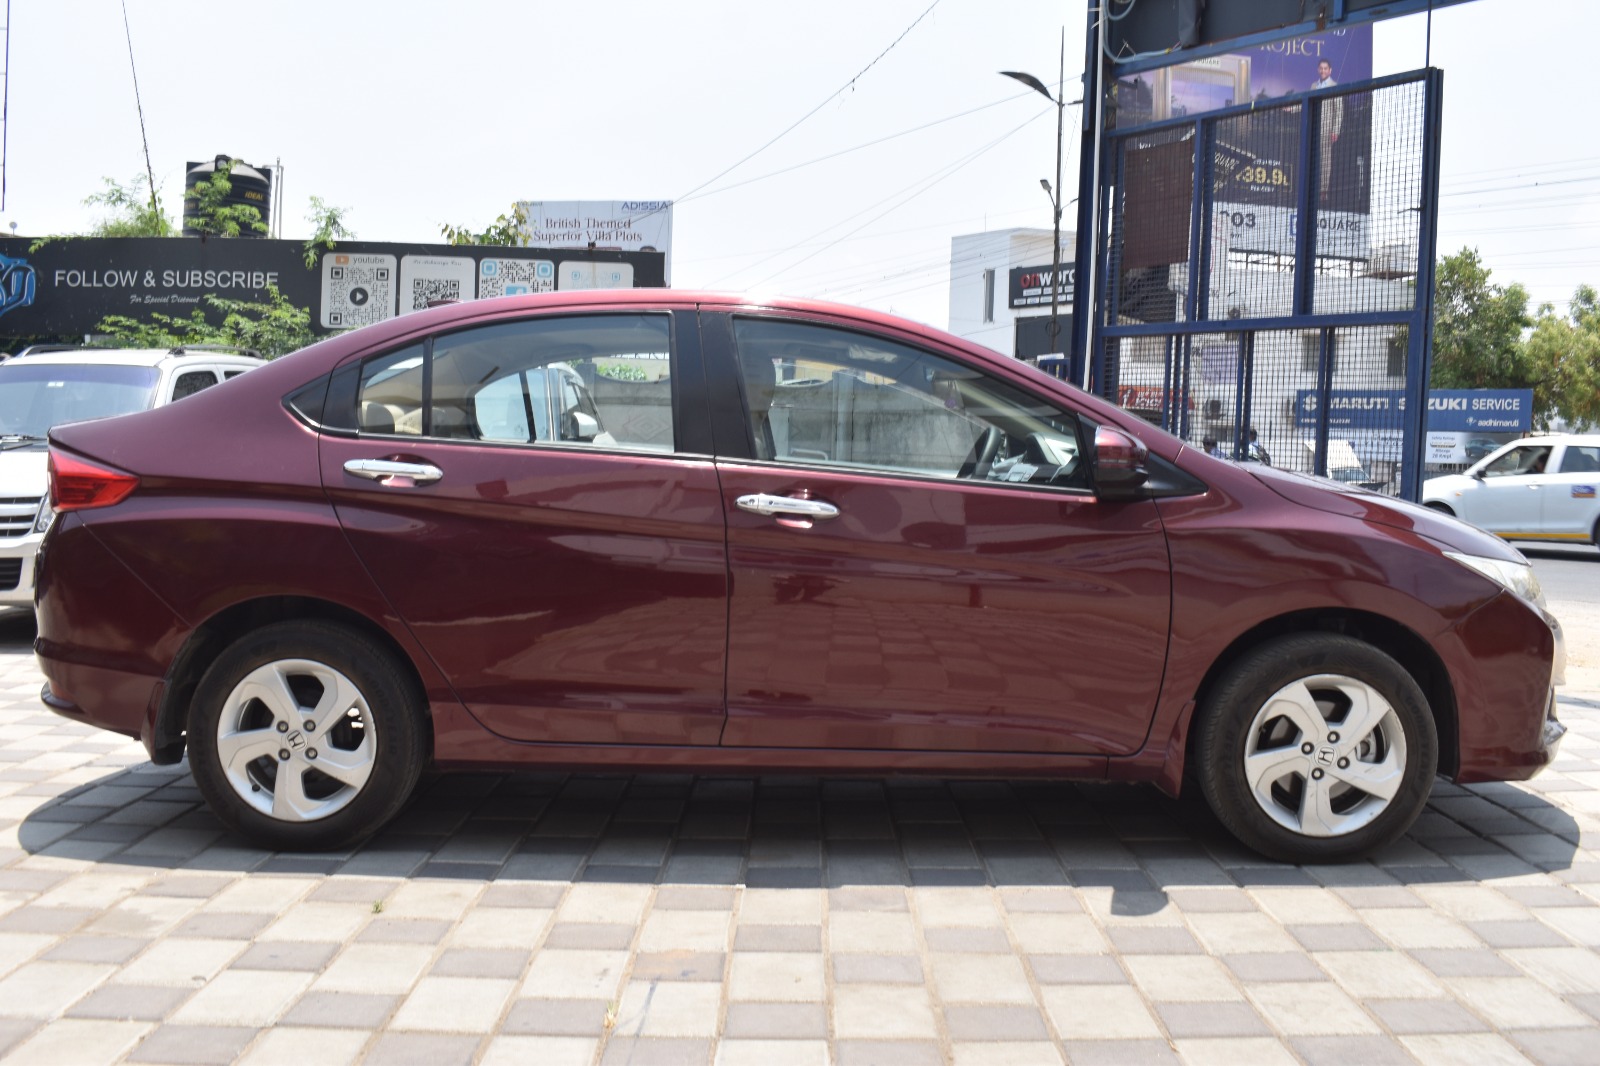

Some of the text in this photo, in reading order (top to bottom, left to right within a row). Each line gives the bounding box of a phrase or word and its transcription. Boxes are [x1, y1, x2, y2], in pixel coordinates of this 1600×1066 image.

[621, 201, 669, 211] ADISSIA
[545, 217, 632, 229] British Themed
[533, 230, 643, 244] Superior Villa Plots
[352, 256, 385, 265] youtube
[54, 269, 279, 289] FOLLOW & SUBSCRIBE
[129, 293, 142, 304] For
[144, 294, 170, 305] Special
[1330, 396, 1521, 411] MARUTI SZUKI SERVICE
